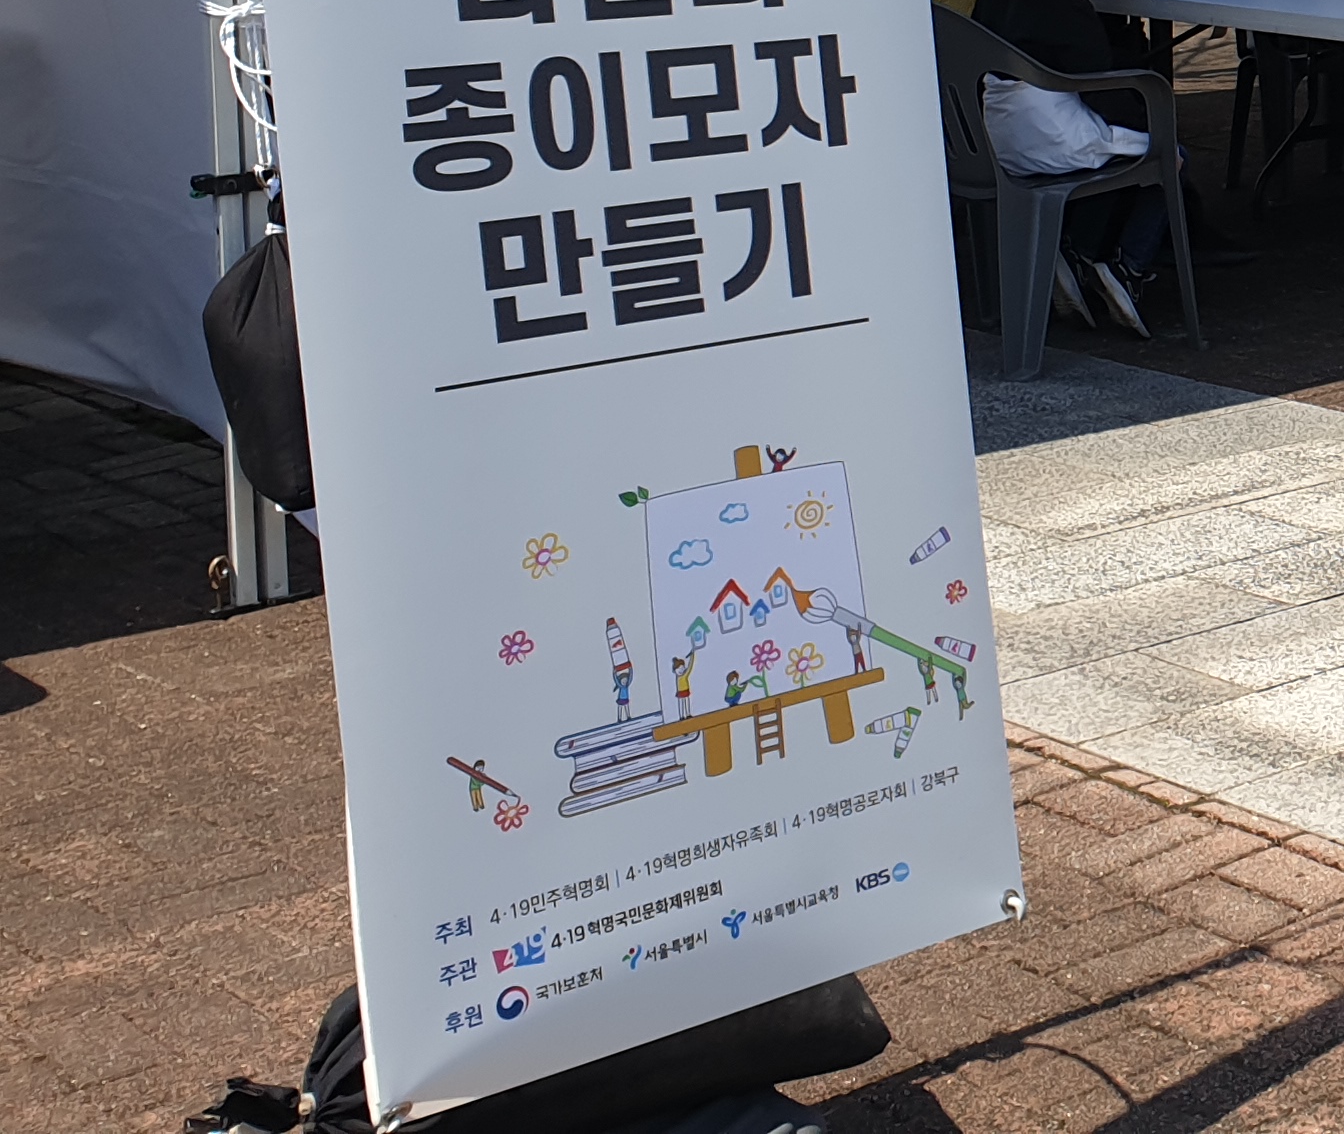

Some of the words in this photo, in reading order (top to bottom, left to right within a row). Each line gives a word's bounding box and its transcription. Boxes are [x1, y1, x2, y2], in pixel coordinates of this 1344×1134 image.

[401, 34, 858, 194] 종이모자
[478, 181, 814, 345] 만들기
[434, 916, 473, 944] 주최
[920, 766, 960, 792] 강북구
[439, 957, 478, 987] 주관
[587, 880, 723, 936] 혁명국민문화제위원회
[445, 1004, 483, 1034] 후원
[535, 966, 603, 1000] 국가보훈처
[644, 930, 708, 962] 서울특별시
[751, 884, 839, 925] 서울특별시교육청
[855, 868, 891, 893] KBS
